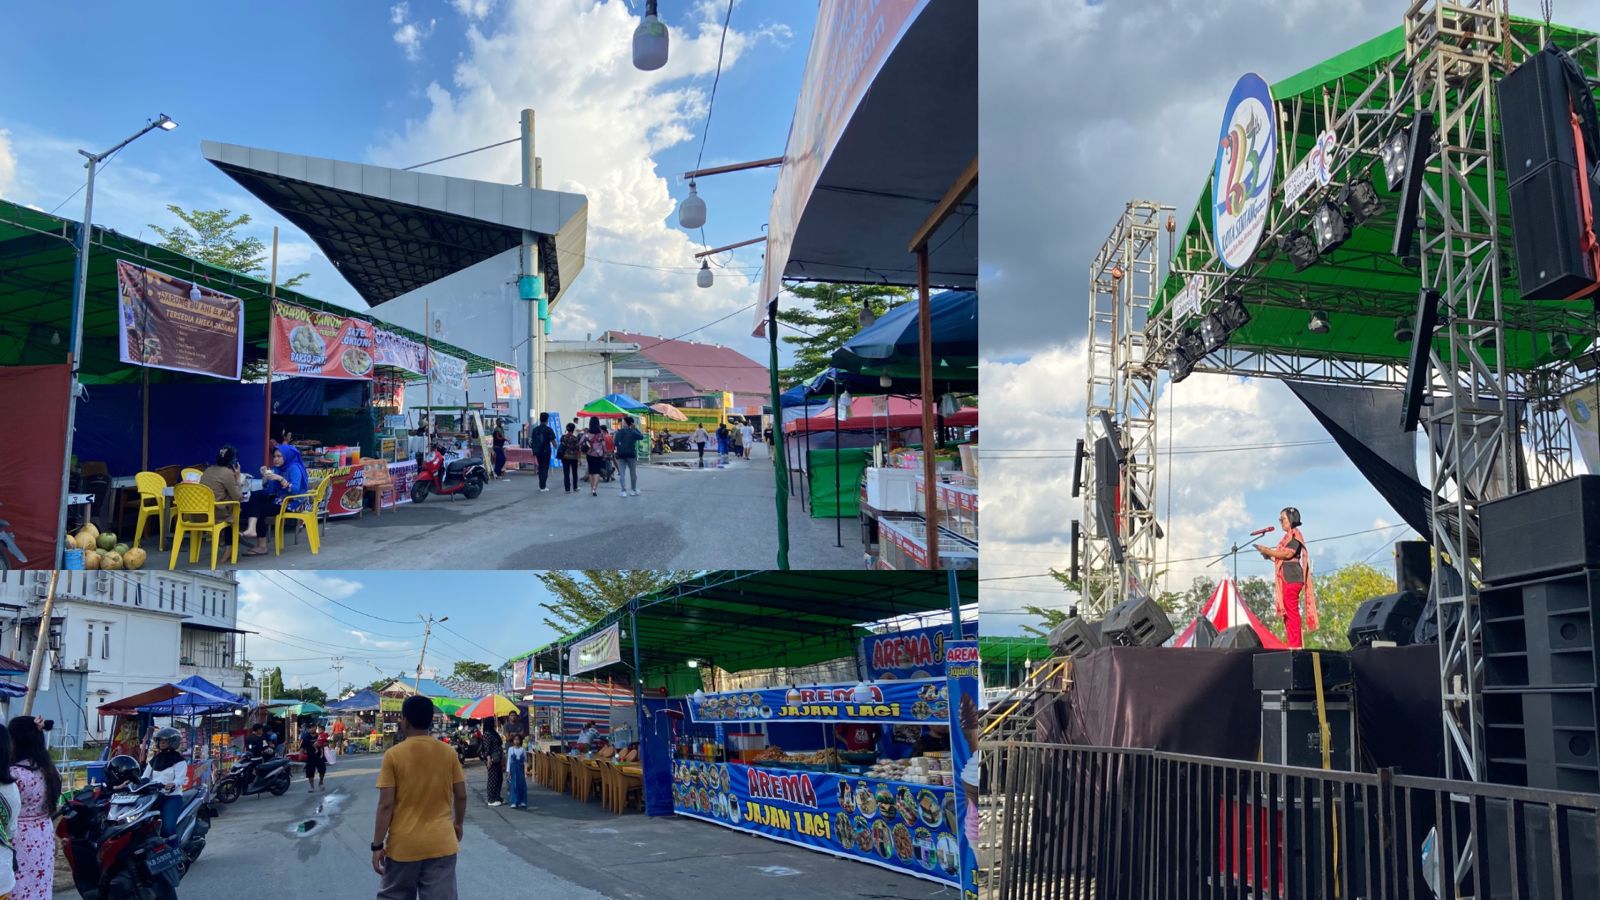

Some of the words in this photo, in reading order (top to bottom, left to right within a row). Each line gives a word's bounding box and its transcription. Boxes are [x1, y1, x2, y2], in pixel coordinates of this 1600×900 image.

[159, 290, 188, 308] WARUNG
[166, 309, 195, 323] TERSEDIA
[195, 317, 214, 328] ANEKA
[275, 302, 312, 321] PONDOK
[290, 352, 312, 364] BAKSO
[873, 633, 934, 670] AREMA
[778, 705, 838, 717] JAJAN
[747, 767, 818, 810] AREMA
[743, 801, 791, 830] JAJAN
